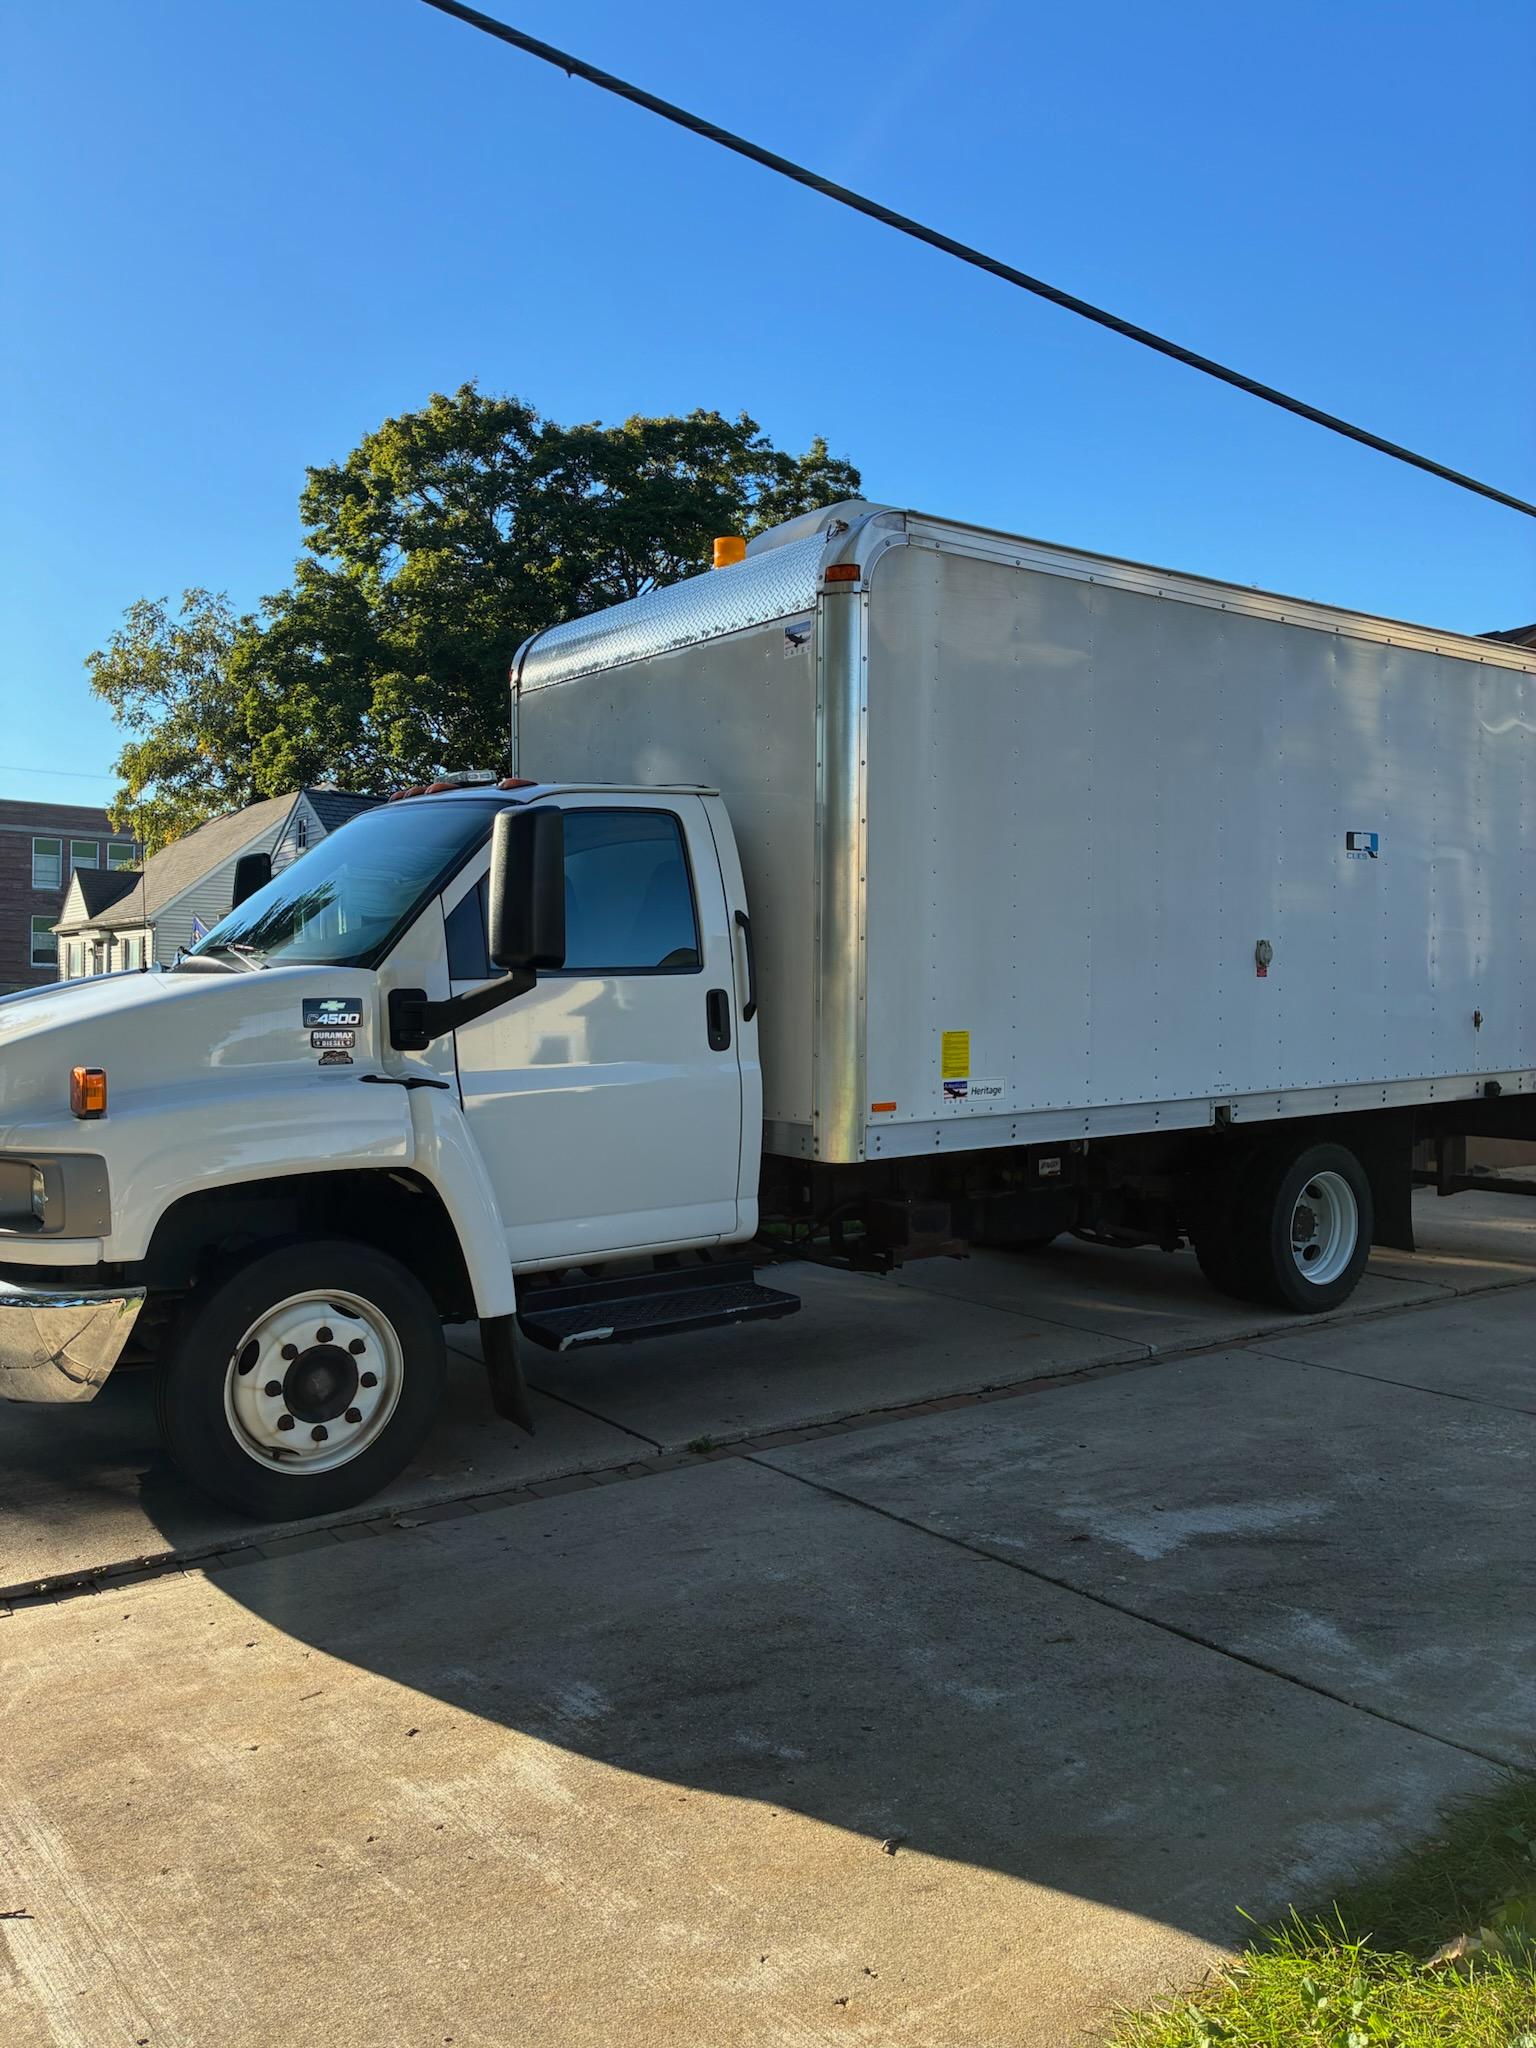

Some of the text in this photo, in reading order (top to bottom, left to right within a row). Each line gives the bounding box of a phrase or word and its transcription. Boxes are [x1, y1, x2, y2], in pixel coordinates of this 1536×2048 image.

[306, 1013, 360, 1025] C4500
[313, 1031, 353, 1039] DURAMAX
[971, 1086, 1002, 1097] Heritage
